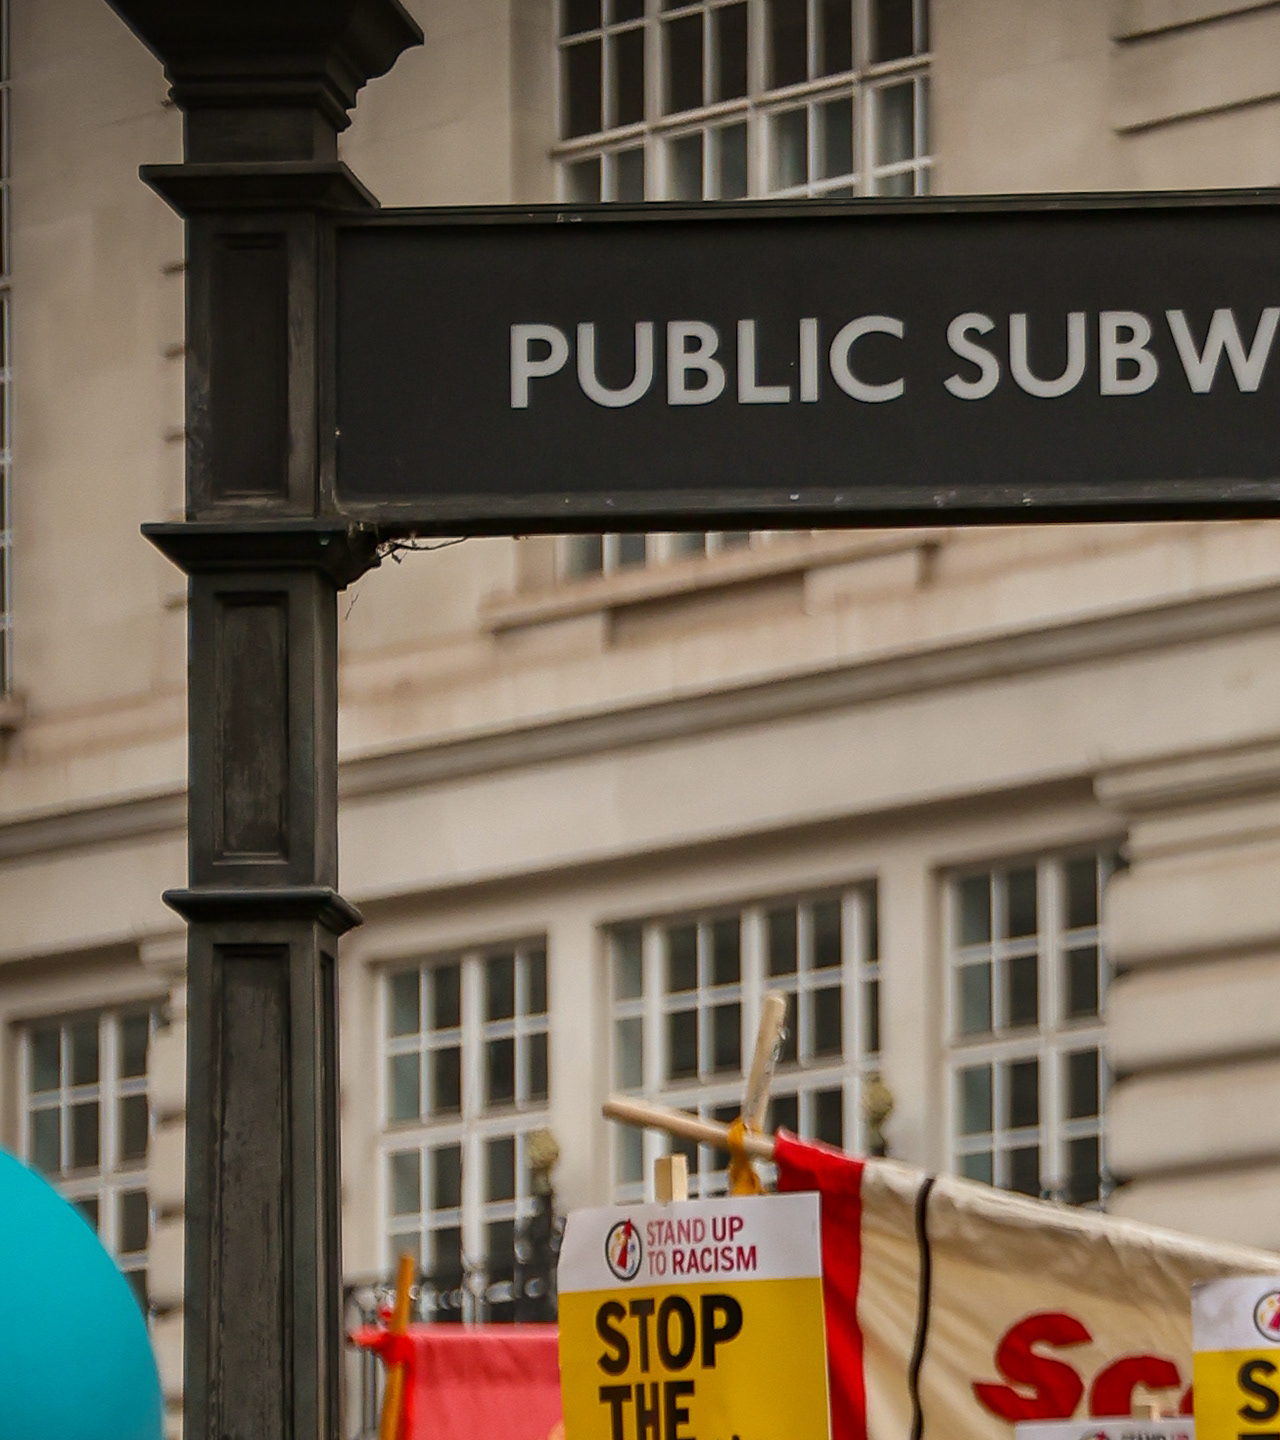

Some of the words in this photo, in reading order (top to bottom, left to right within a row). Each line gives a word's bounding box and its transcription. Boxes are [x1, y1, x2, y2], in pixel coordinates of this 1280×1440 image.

[508, 315, 906, 409] PUBLIC
[646, 1217, 706, 1247] STAND
[711, 1215, 744, 1243] UP
[647, 1250, 668, 1278] TO
[672, 1244, 759, 1276] RACISM
[594, 1293, 745, 1377] STOP
